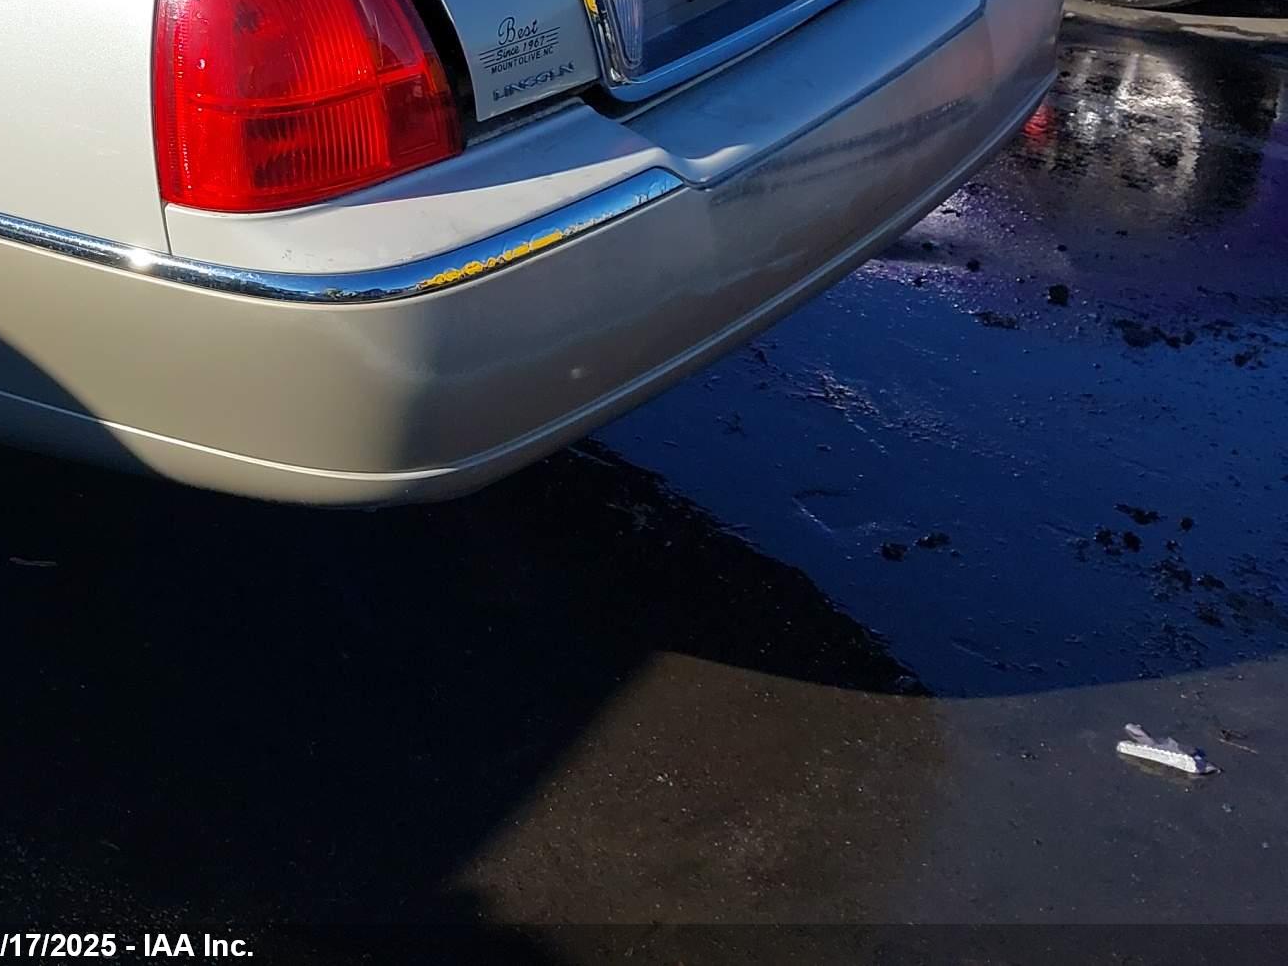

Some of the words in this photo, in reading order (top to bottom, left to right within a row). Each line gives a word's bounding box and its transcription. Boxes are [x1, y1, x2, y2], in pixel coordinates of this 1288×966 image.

[498, 16, 537, 45] Best
[496, 45, 520, 60] Since
[522, 36, 546, 52] 1967
[493, 61, 574, 101] LINCOLN
